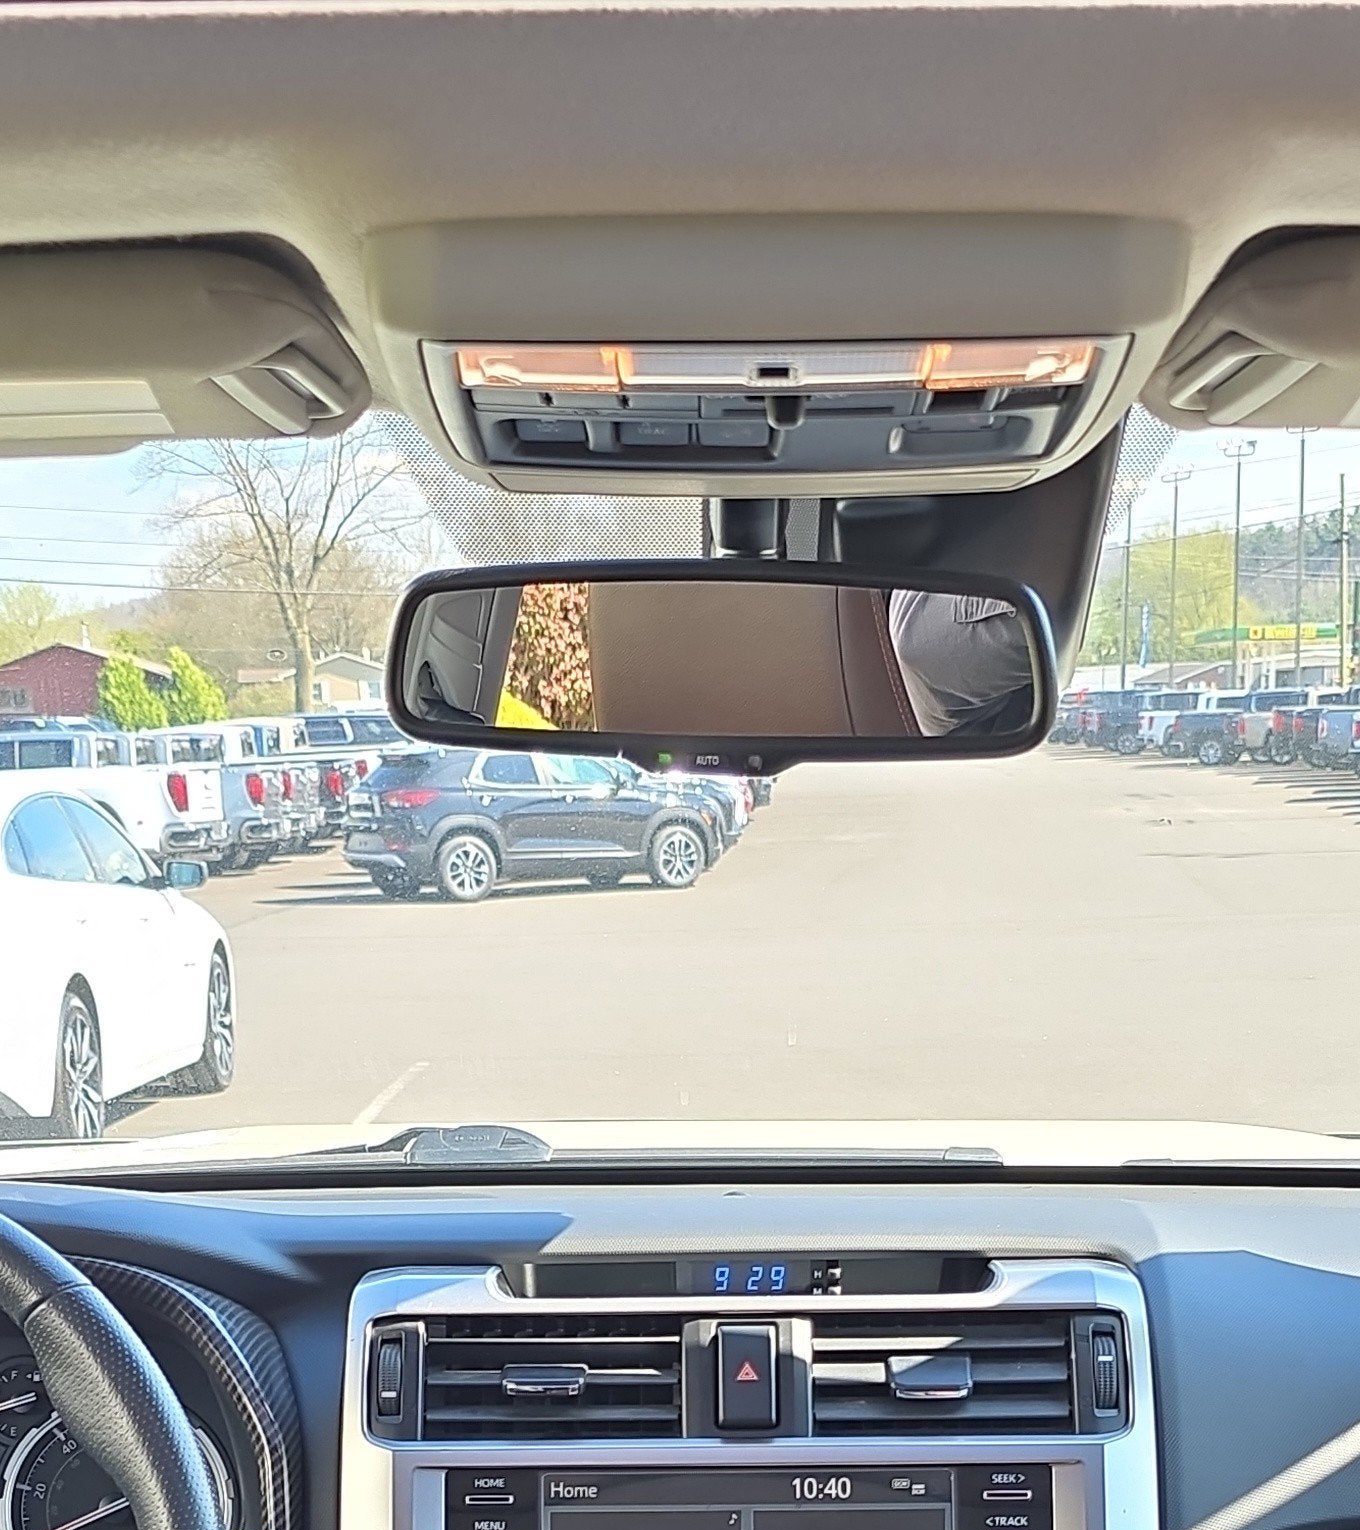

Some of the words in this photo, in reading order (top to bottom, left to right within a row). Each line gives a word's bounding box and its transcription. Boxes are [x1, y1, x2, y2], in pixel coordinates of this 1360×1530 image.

[696, 755, 720, 765] AUTO
[11, 1370, 18, 1380] F
[10, 1427, 18, 1437] E
[61, 1439, 78, 1455] 40
[474, 1478, 505, 1488] HOME
[791, 1477, 851, 1499] 10:40
[33, 1483, 47, 1500] 20
[550, 1482, 598, 1498] Home
[474, 1521, 505, 1530] MENU
